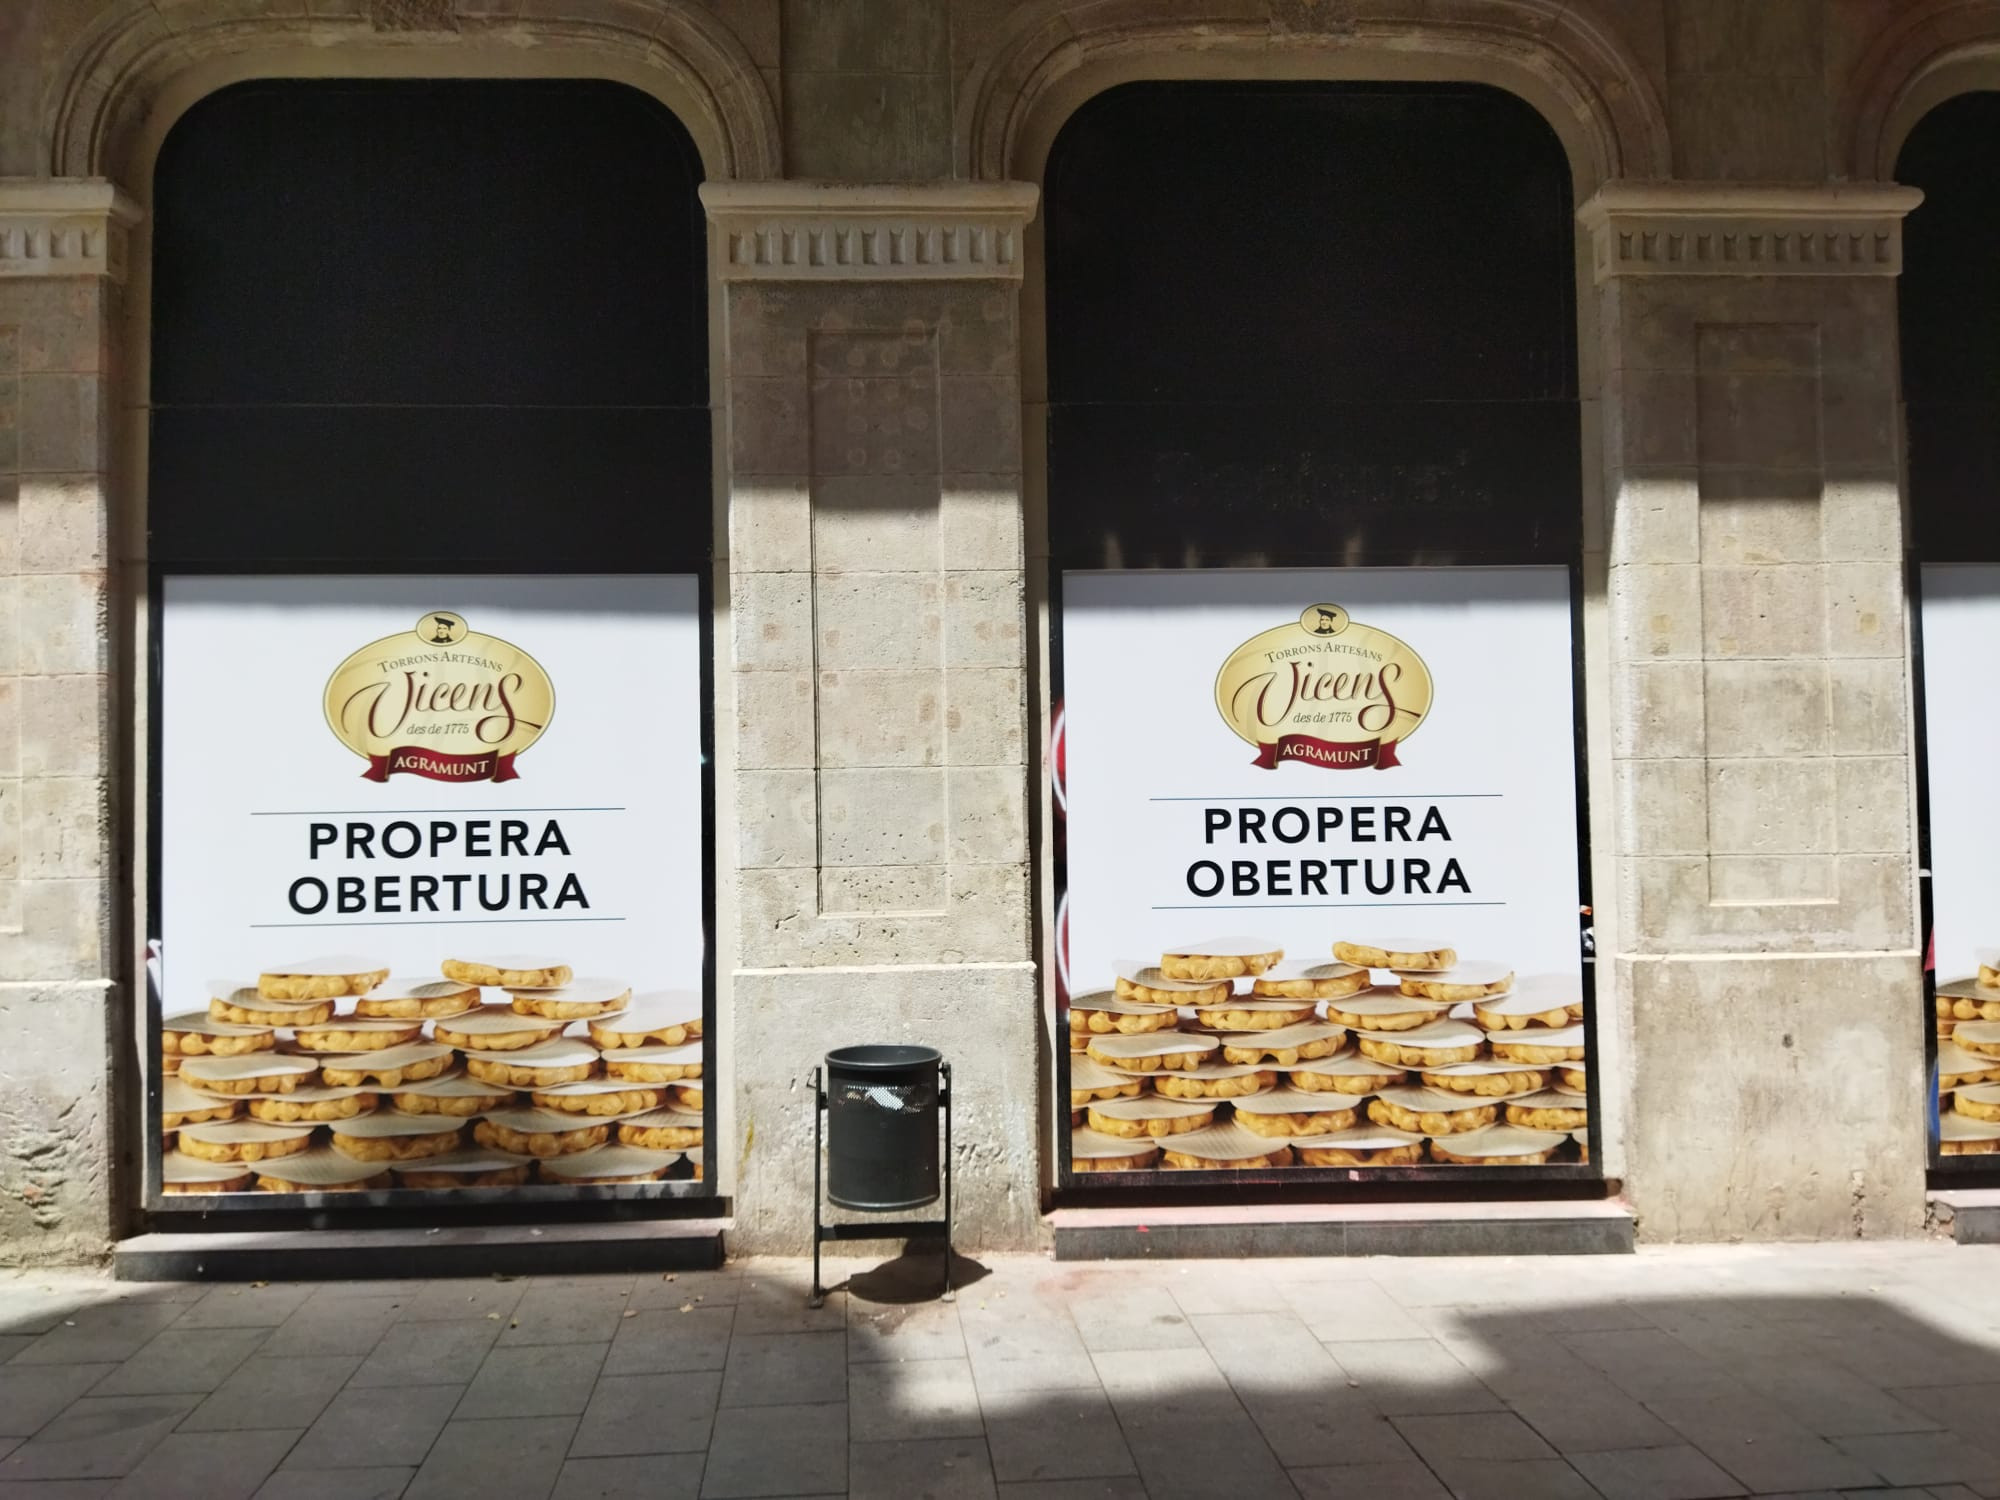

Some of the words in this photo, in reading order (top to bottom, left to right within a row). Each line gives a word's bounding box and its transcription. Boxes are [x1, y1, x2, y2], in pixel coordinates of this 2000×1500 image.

[444, 723, 470, 735] 1775
[1328, 711, 1352, 723] 1775
[394, 755, 489, 776] AGRAMUNT
[1282, 743, 1372, 764] AGRAMUNT
[309, 819, 572, 860] PROPERA
[1204, 805, 1452, 845] PROPERA
[1186, 857, 1472, 898] OBERTURA
[288, 872, 591, 916] OBERTURA
